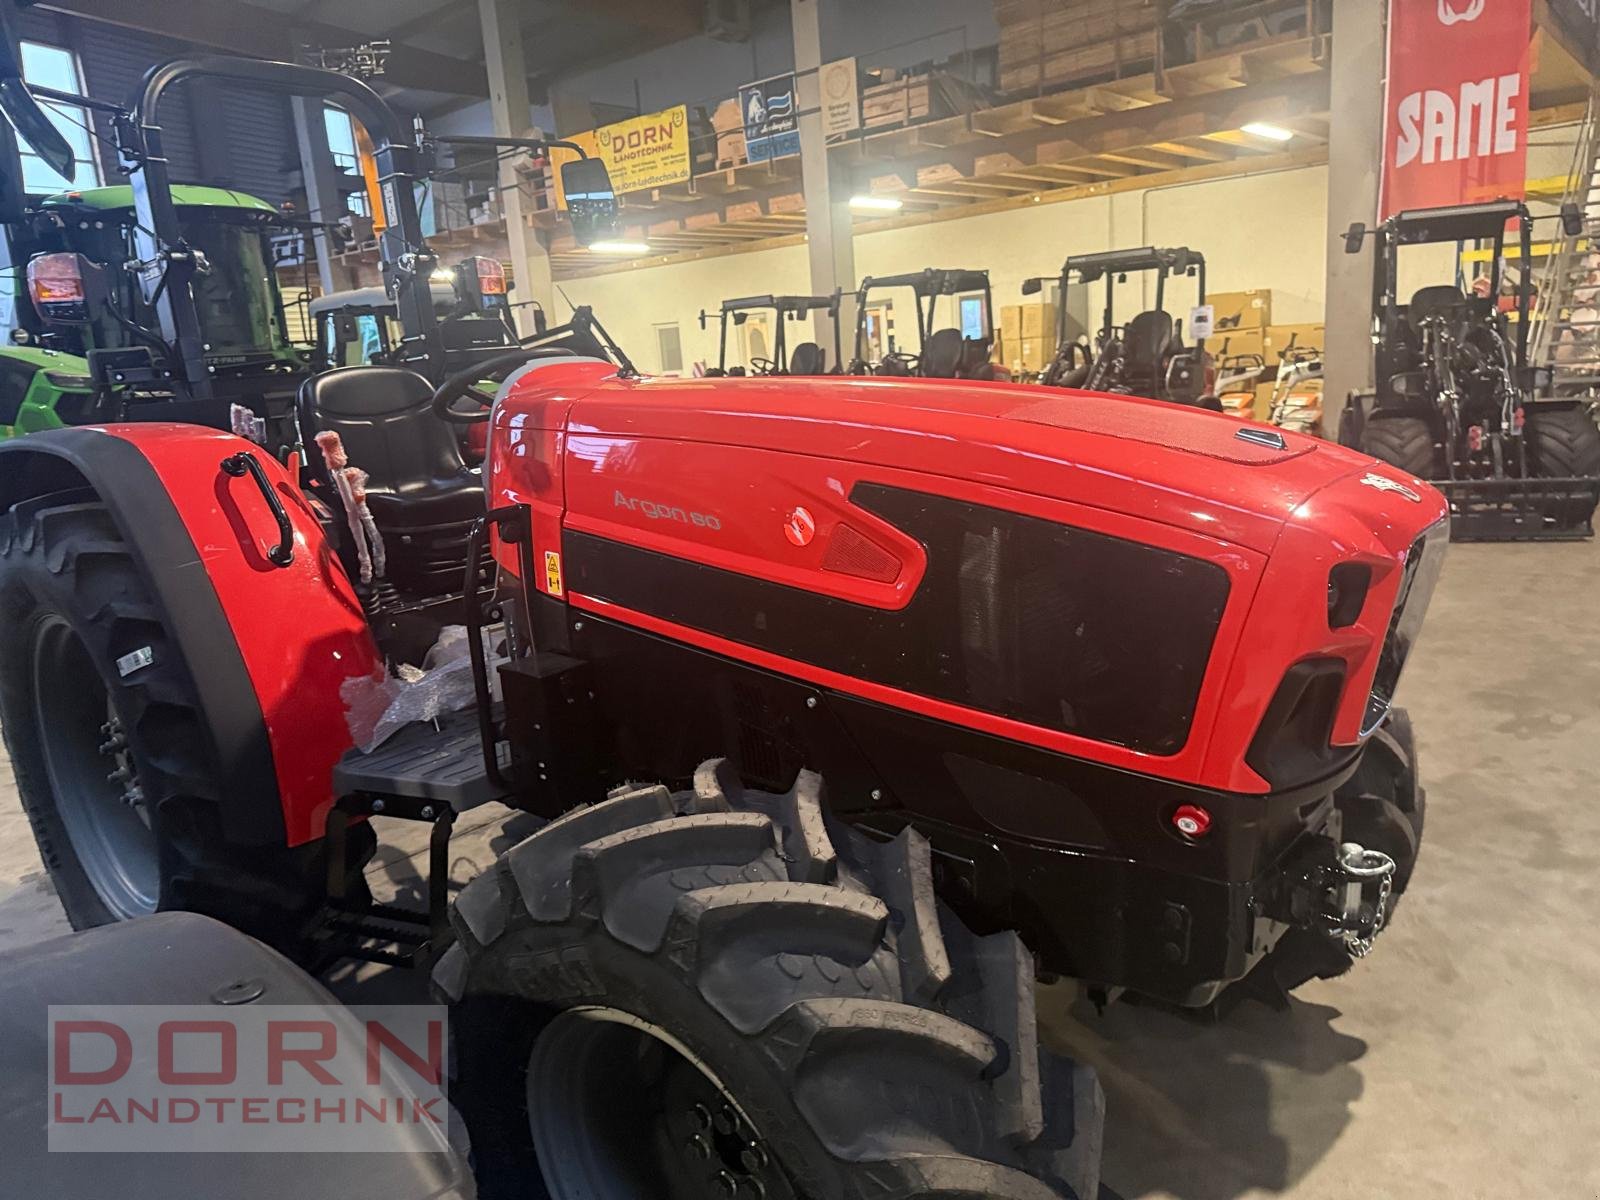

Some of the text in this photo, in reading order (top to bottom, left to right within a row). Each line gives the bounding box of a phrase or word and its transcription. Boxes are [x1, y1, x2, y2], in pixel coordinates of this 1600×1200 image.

[1395, 72, 1520, 168] SAME
[612, 122, 673, 154] DORN
[613, 142, 673, 164] LANDTECHNIK
[750, 137, 798, 159] SERVICE
[614, 489, 721, 530] Argon 80
